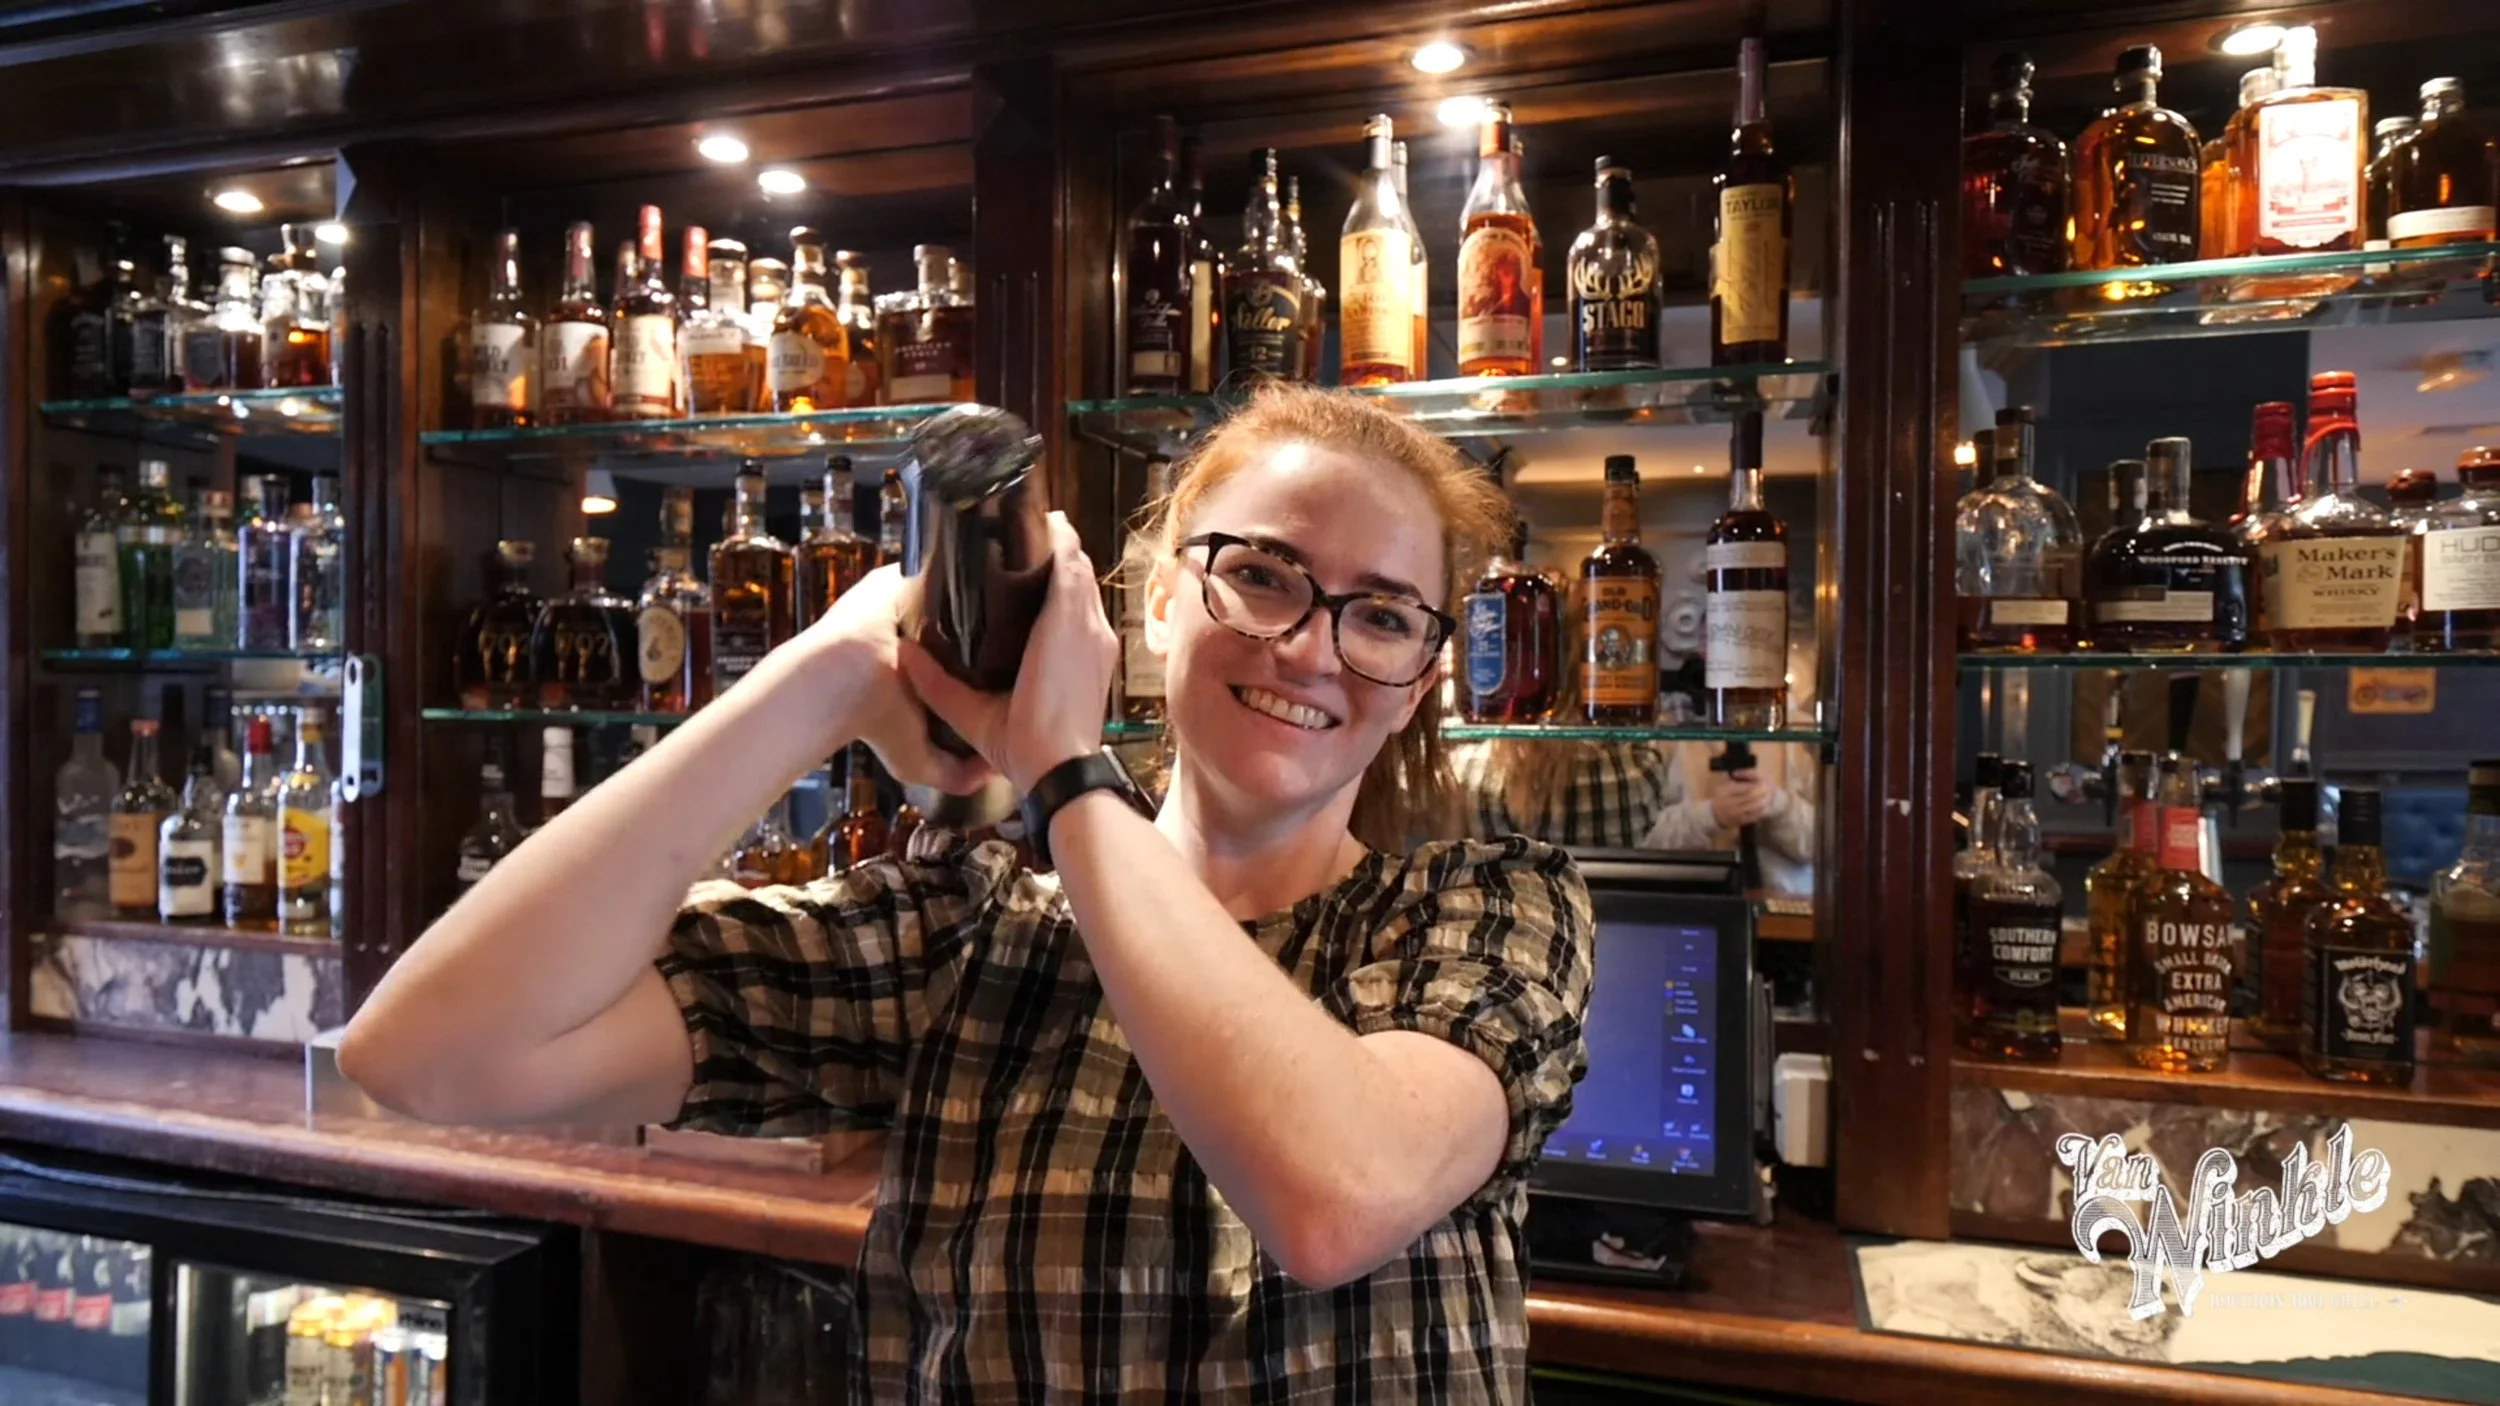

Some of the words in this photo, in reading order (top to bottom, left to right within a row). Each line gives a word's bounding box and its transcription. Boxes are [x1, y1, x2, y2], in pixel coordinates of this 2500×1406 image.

[2297, 547, 2397, 562] Maker's
[2326, 564, 2393, 580] Mark
[2171, 972, 2222, 991] EXTRA
